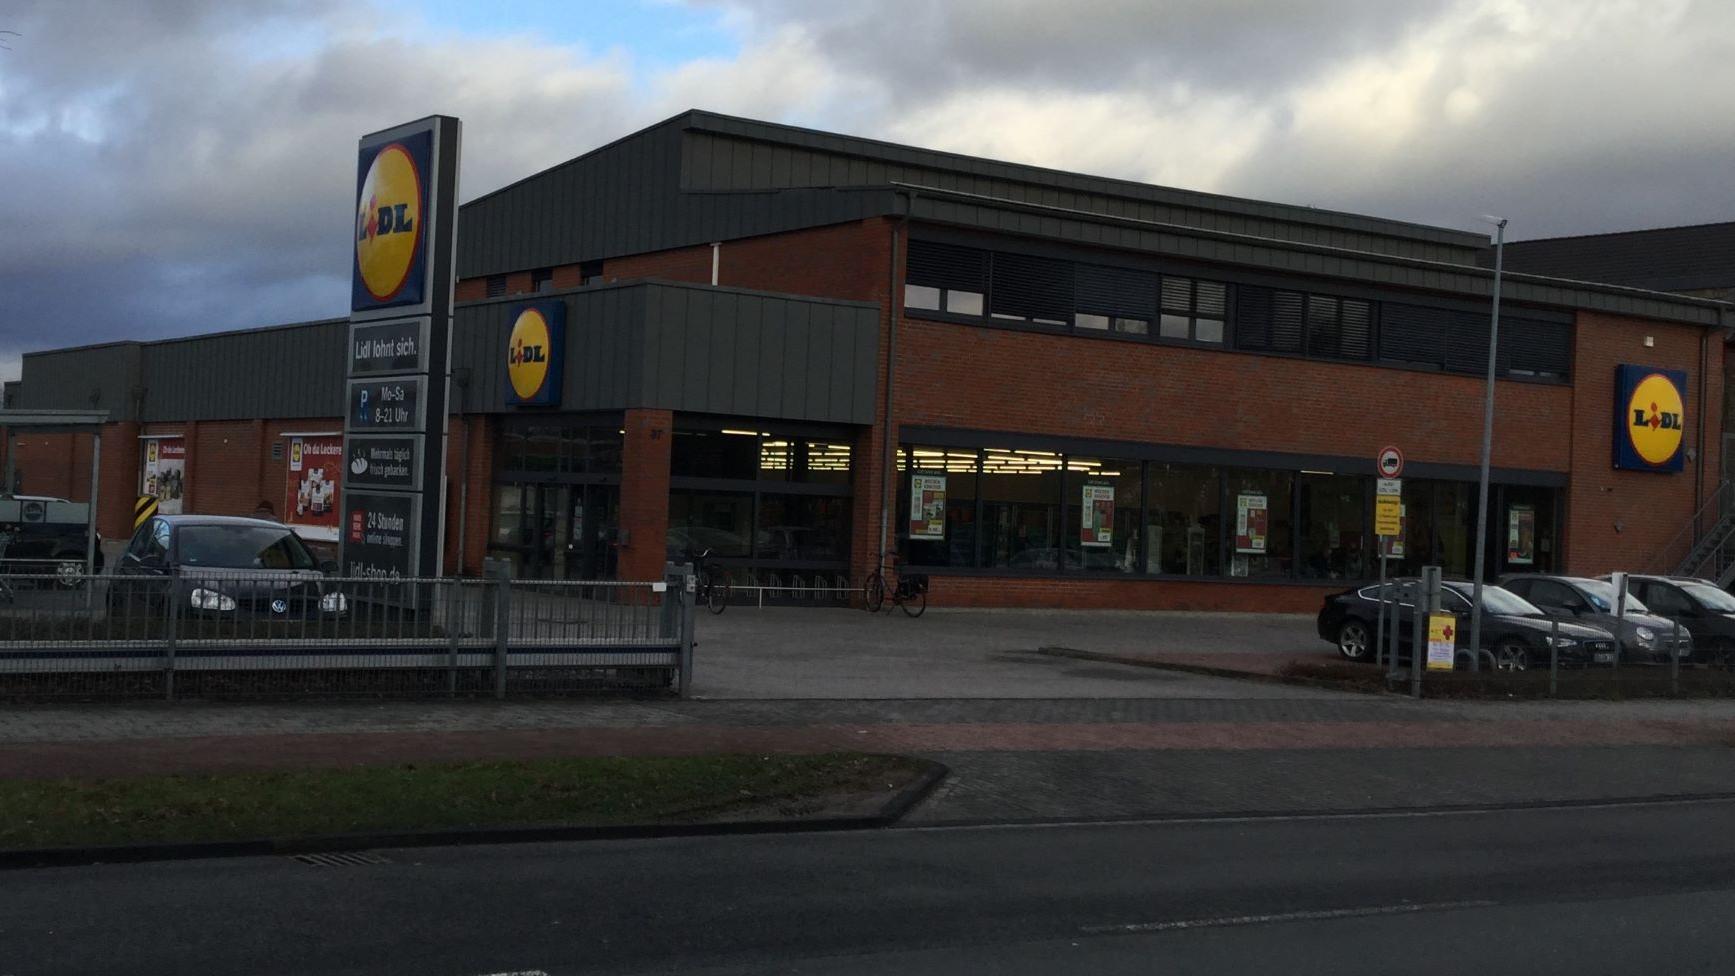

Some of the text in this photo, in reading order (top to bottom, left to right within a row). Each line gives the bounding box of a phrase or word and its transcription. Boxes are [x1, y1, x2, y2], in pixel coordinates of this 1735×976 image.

[355, 336, 417, 359] Lidl lohnt sich.
[375, 407, 409, 423] 8-21 Uhr
[1633, 401, 1681, 431] LIDL
[367, 511, 376, 529] 24
[377, 512, 404, 531] Stunden
[350, 561, 401, 586] lidl-shopde
